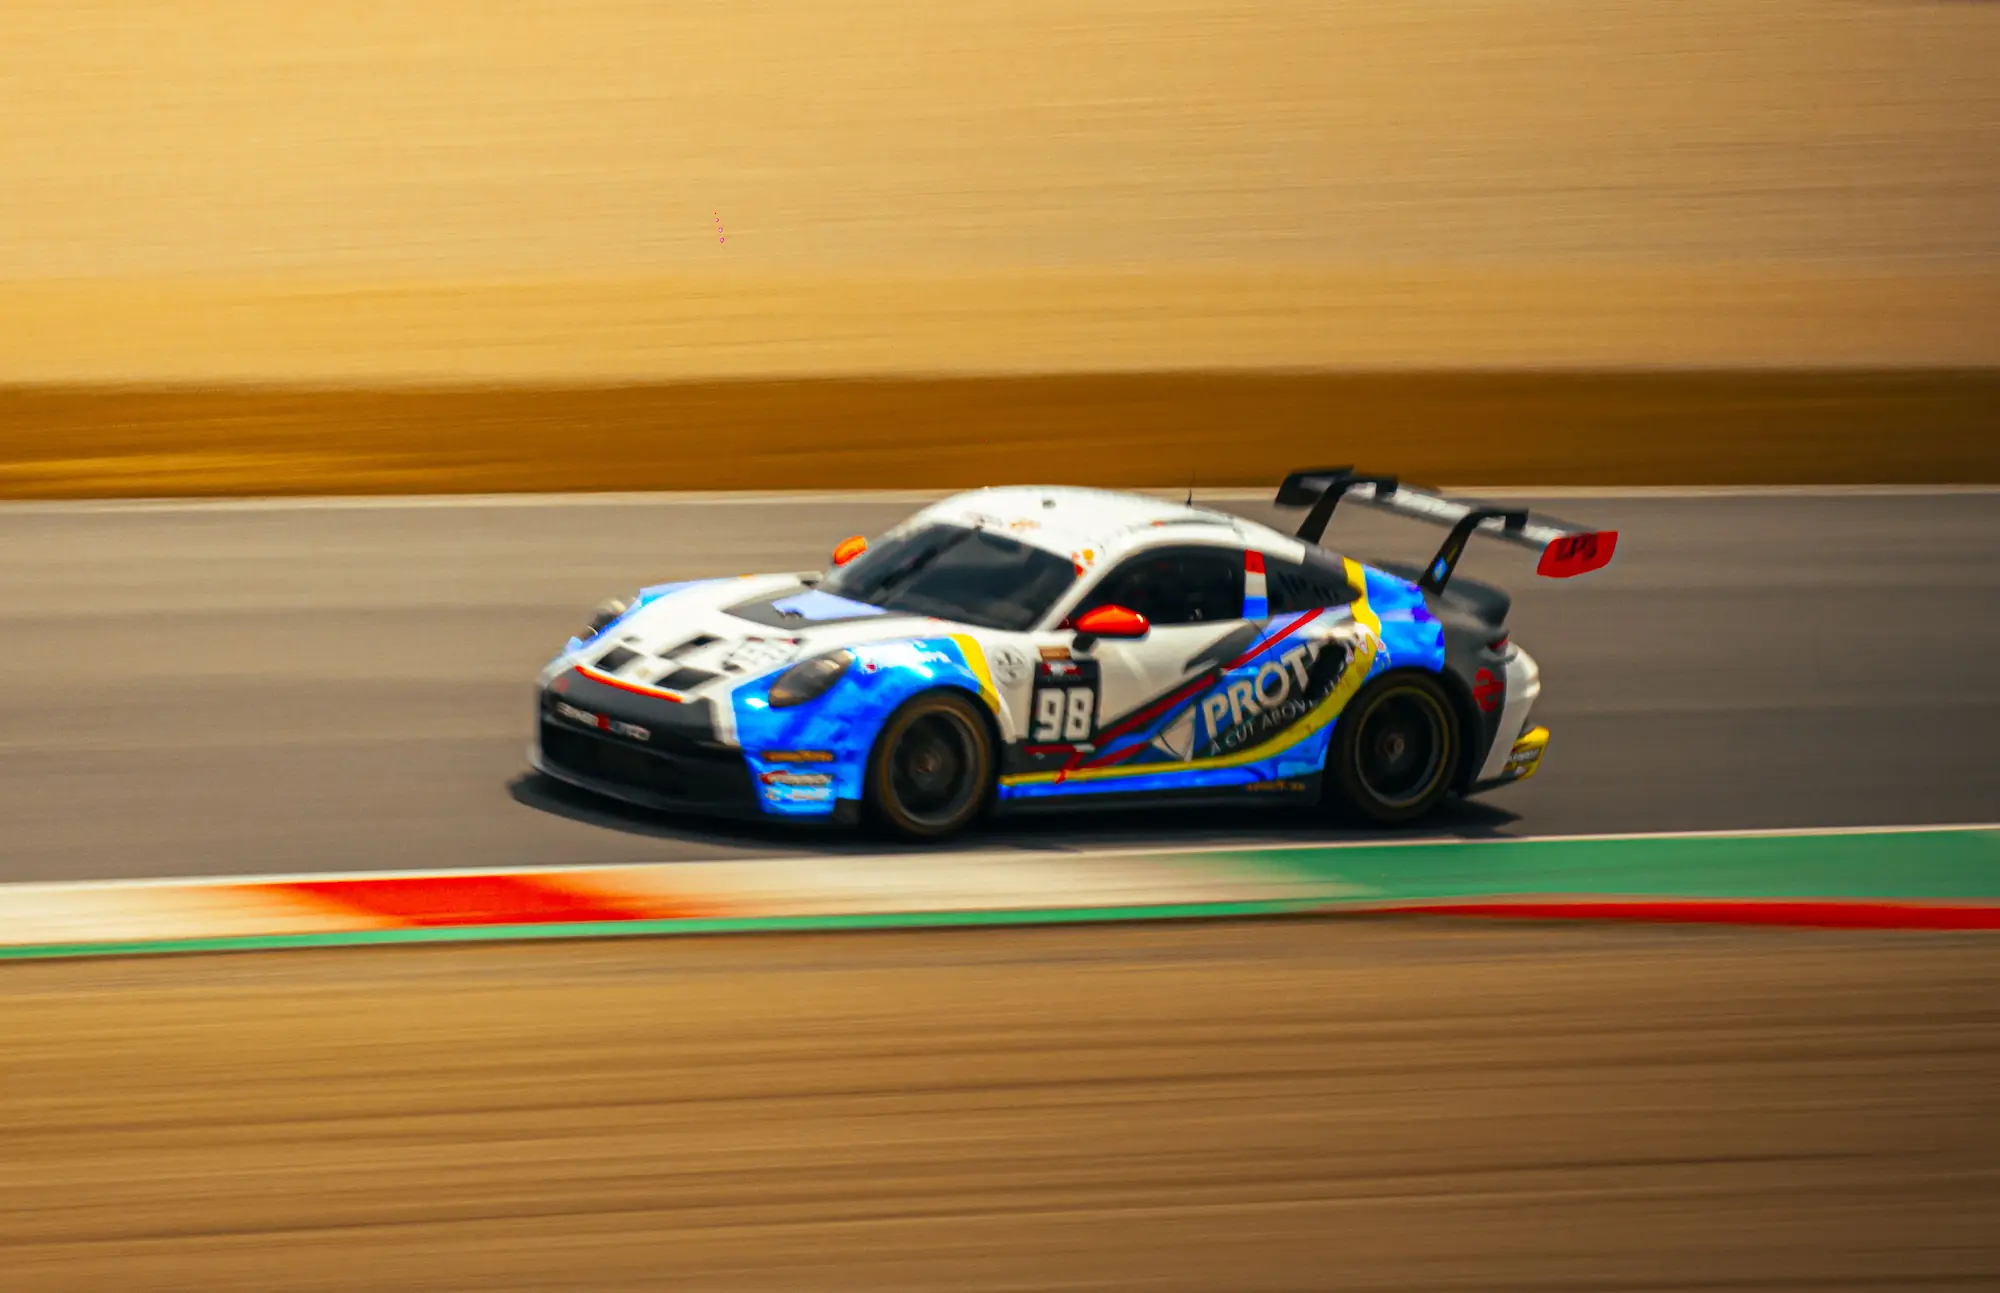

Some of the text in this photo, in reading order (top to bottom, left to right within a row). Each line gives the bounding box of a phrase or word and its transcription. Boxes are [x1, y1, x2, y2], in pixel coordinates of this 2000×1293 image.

[1035, 687, 1094, 742] 98
[1211, 740, 1221, 756] A
[1225, 718, 1255, 748] CUT
